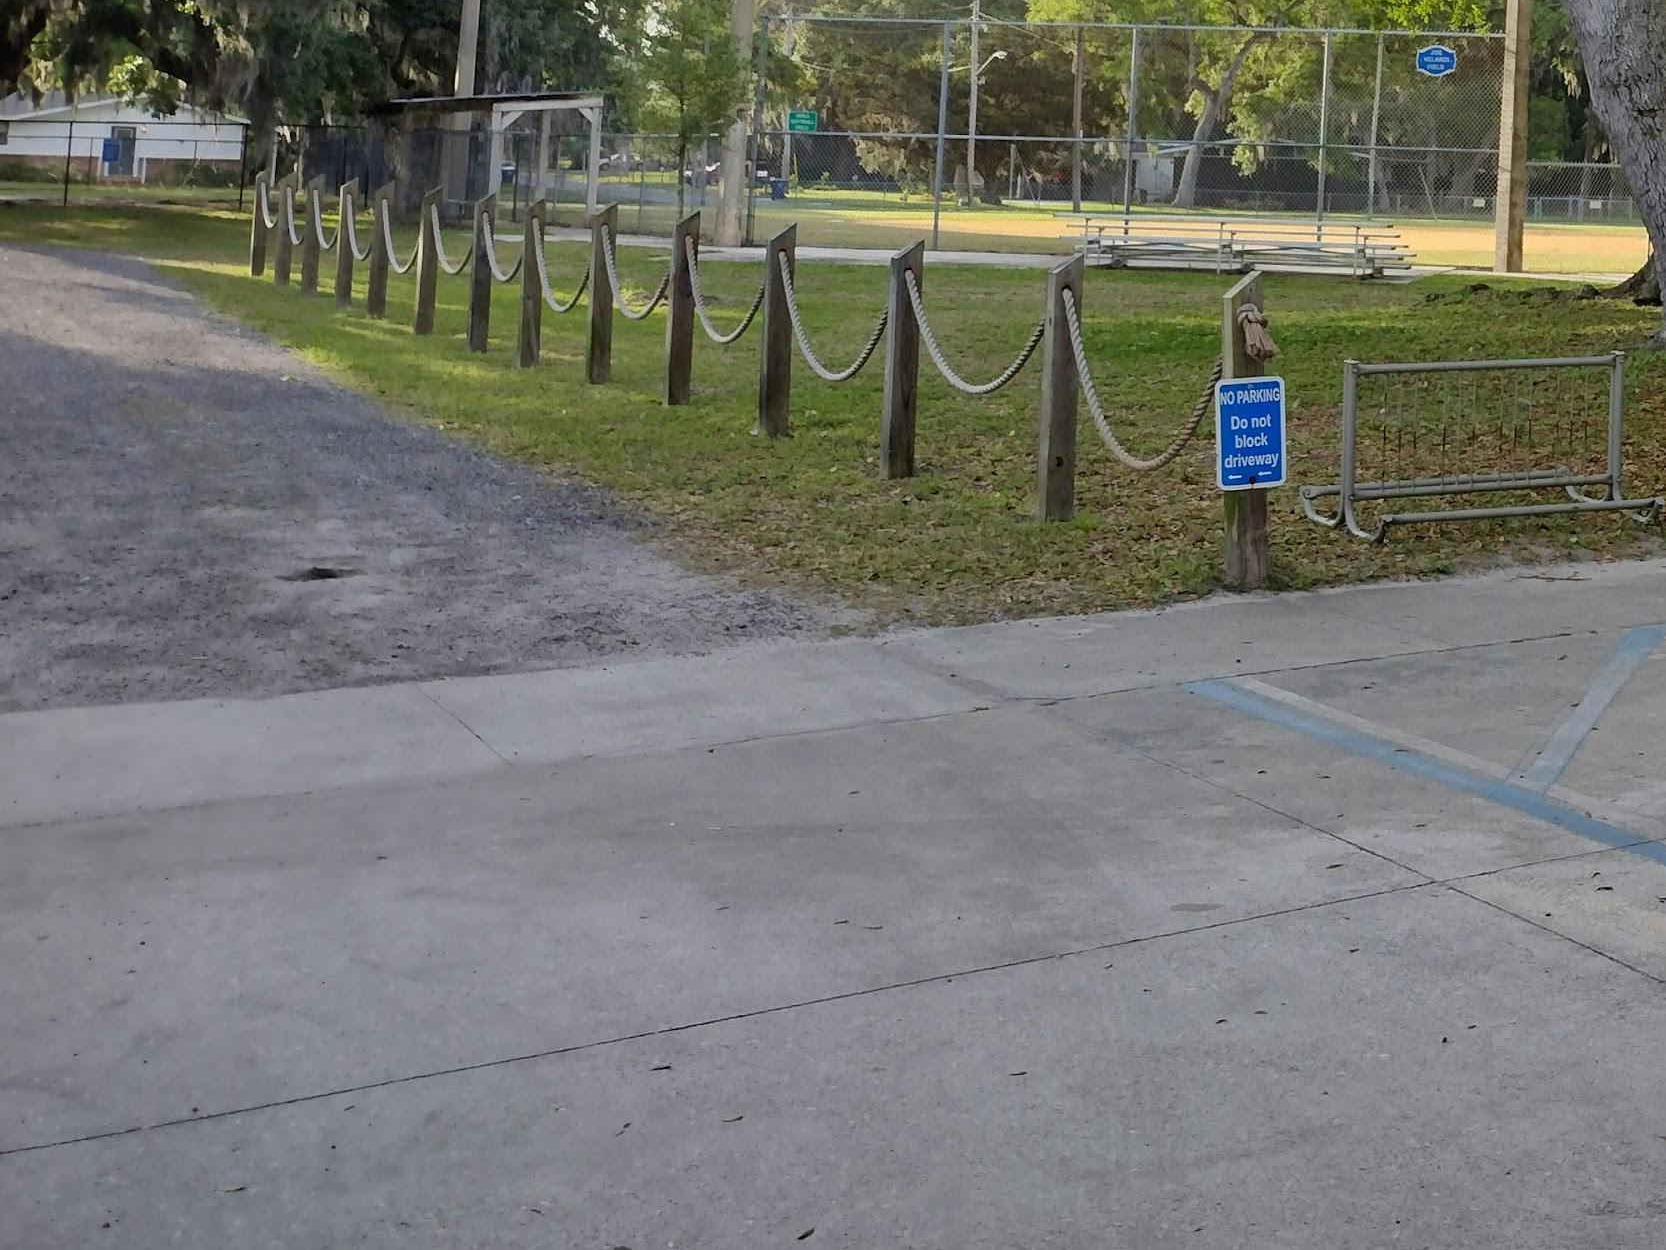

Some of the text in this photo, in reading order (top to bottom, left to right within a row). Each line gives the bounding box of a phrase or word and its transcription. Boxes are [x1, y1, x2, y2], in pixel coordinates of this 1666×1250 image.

[1220, 387, 1280, 406] NO PARKING
[1230, 414, 1272, 430] Do not
[1235, 432, 1268, 449] block
[1224, 452, 1280, 469] driveway
